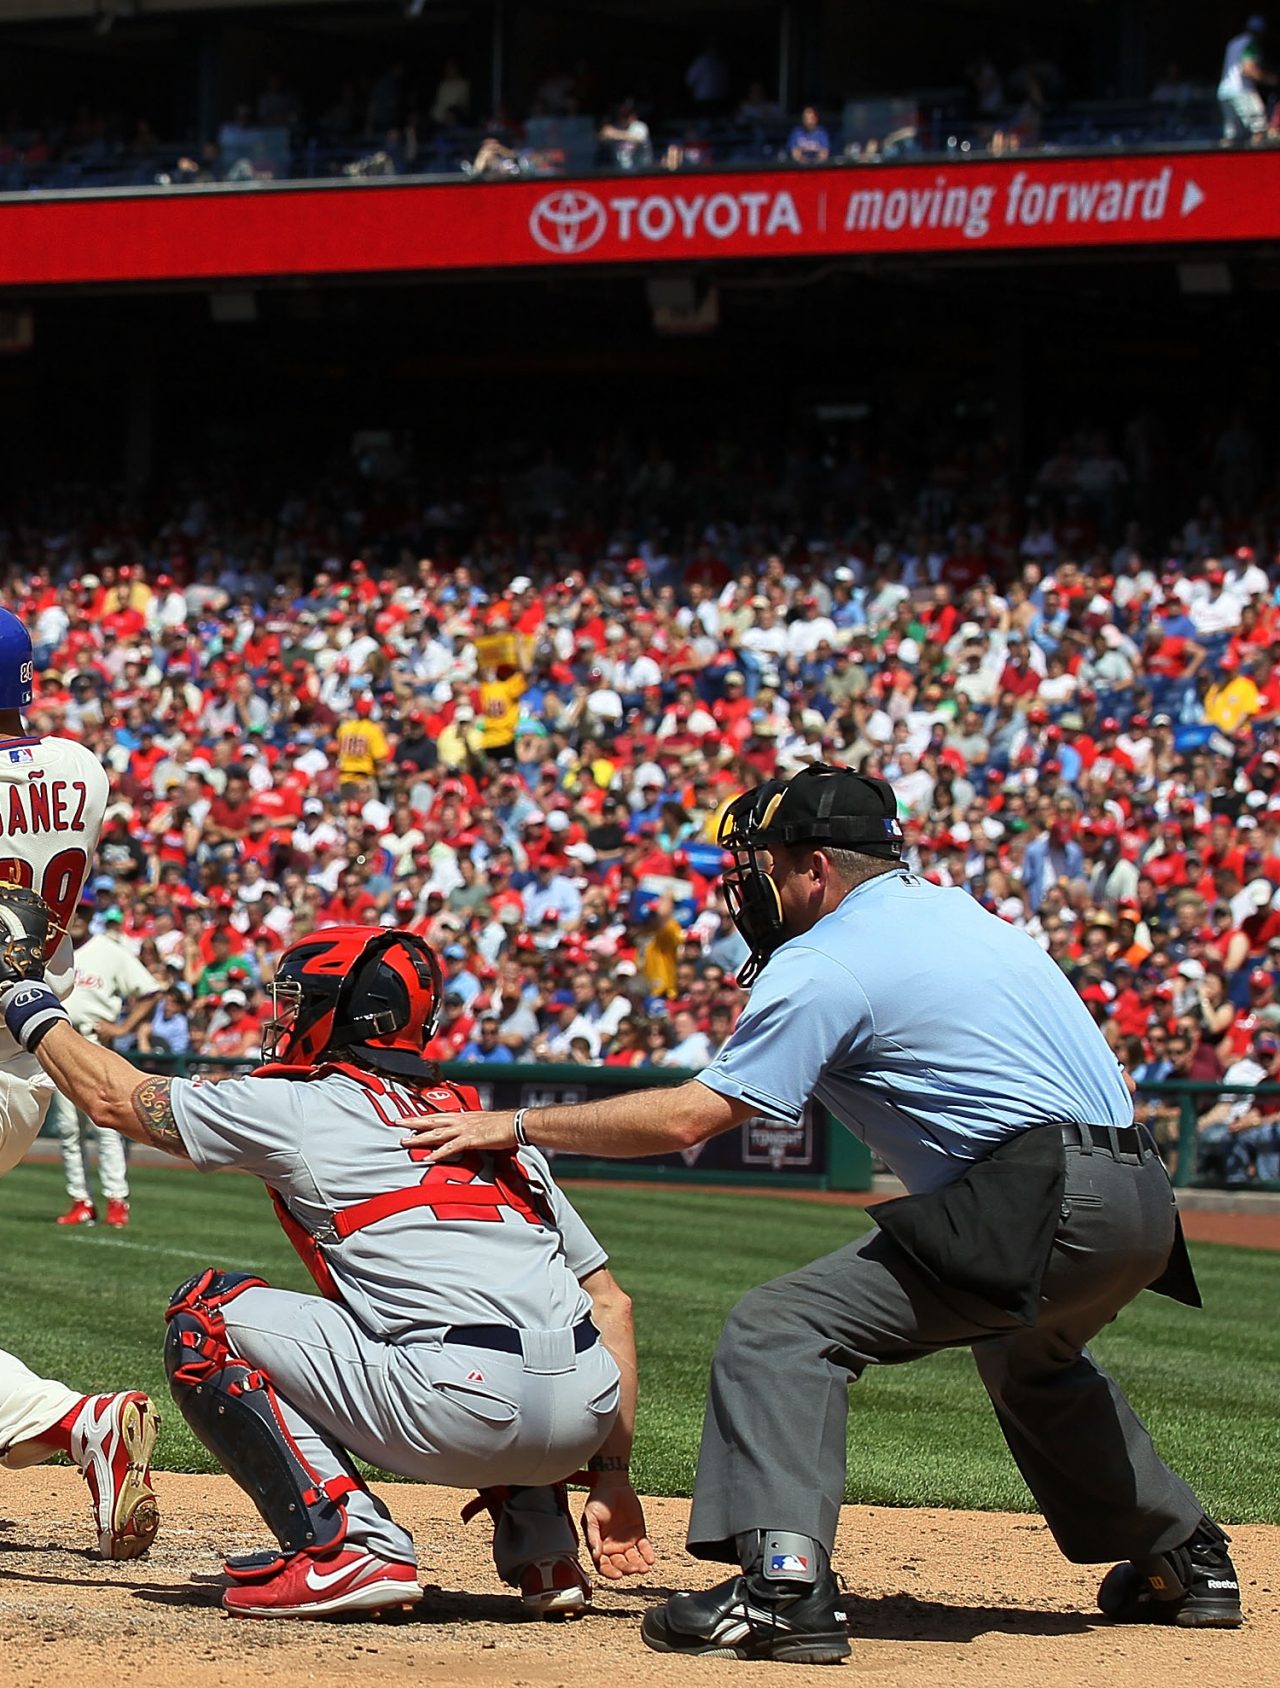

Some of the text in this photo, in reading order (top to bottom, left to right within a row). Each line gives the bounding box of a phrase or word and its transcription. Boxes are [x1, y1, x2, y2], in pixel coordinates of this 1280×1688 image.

[613, 167, 1173, 242] TOYOTA moving forward
